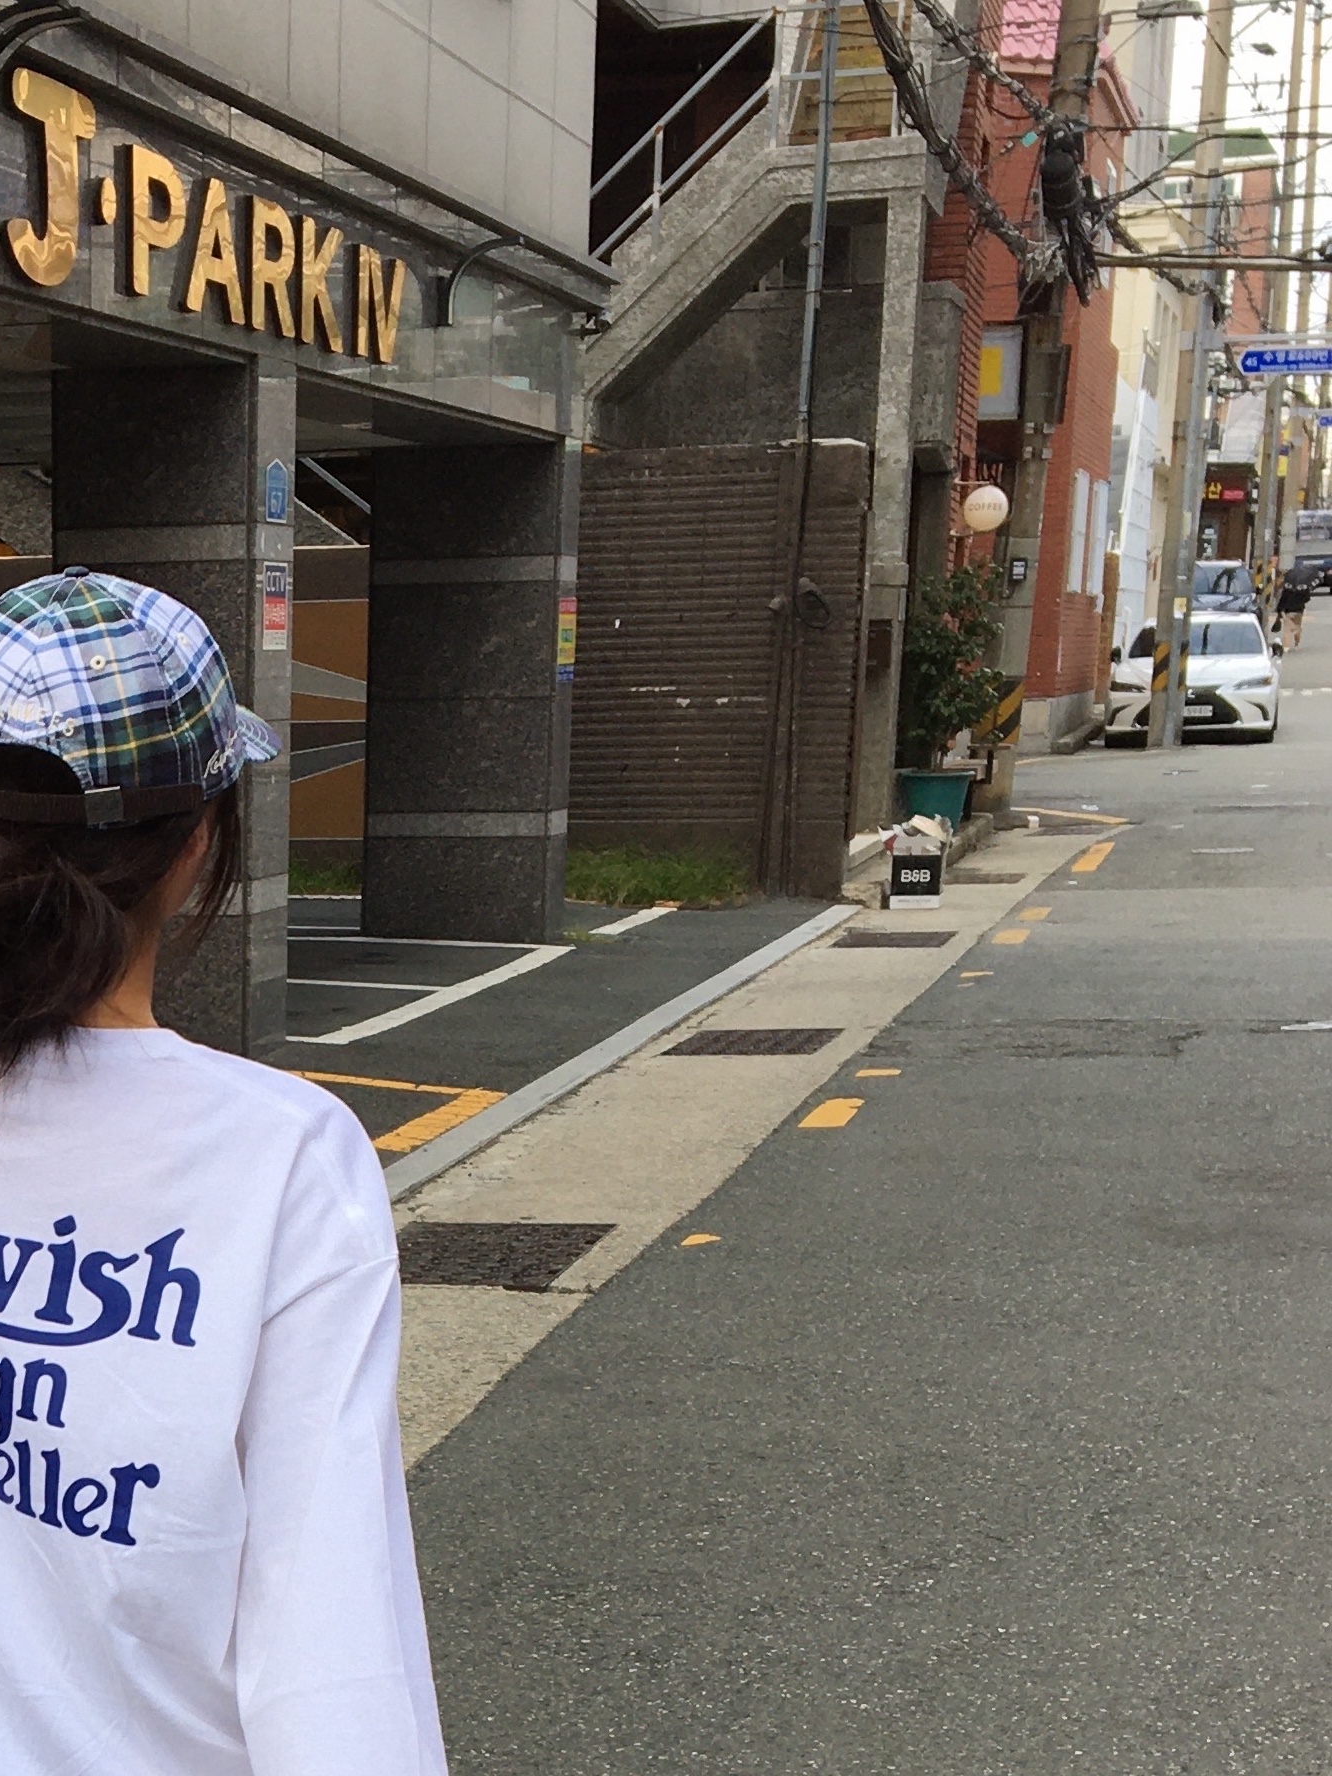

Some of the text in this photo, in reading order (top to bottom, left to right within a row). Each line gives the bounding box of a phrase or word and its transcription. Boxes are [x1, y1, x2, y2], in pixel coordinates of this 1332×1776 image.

[270, 491, 283, 514] 67
[968, 502, 1003, 512] COFFEE
[266, 571, 286, 592] CCTV
